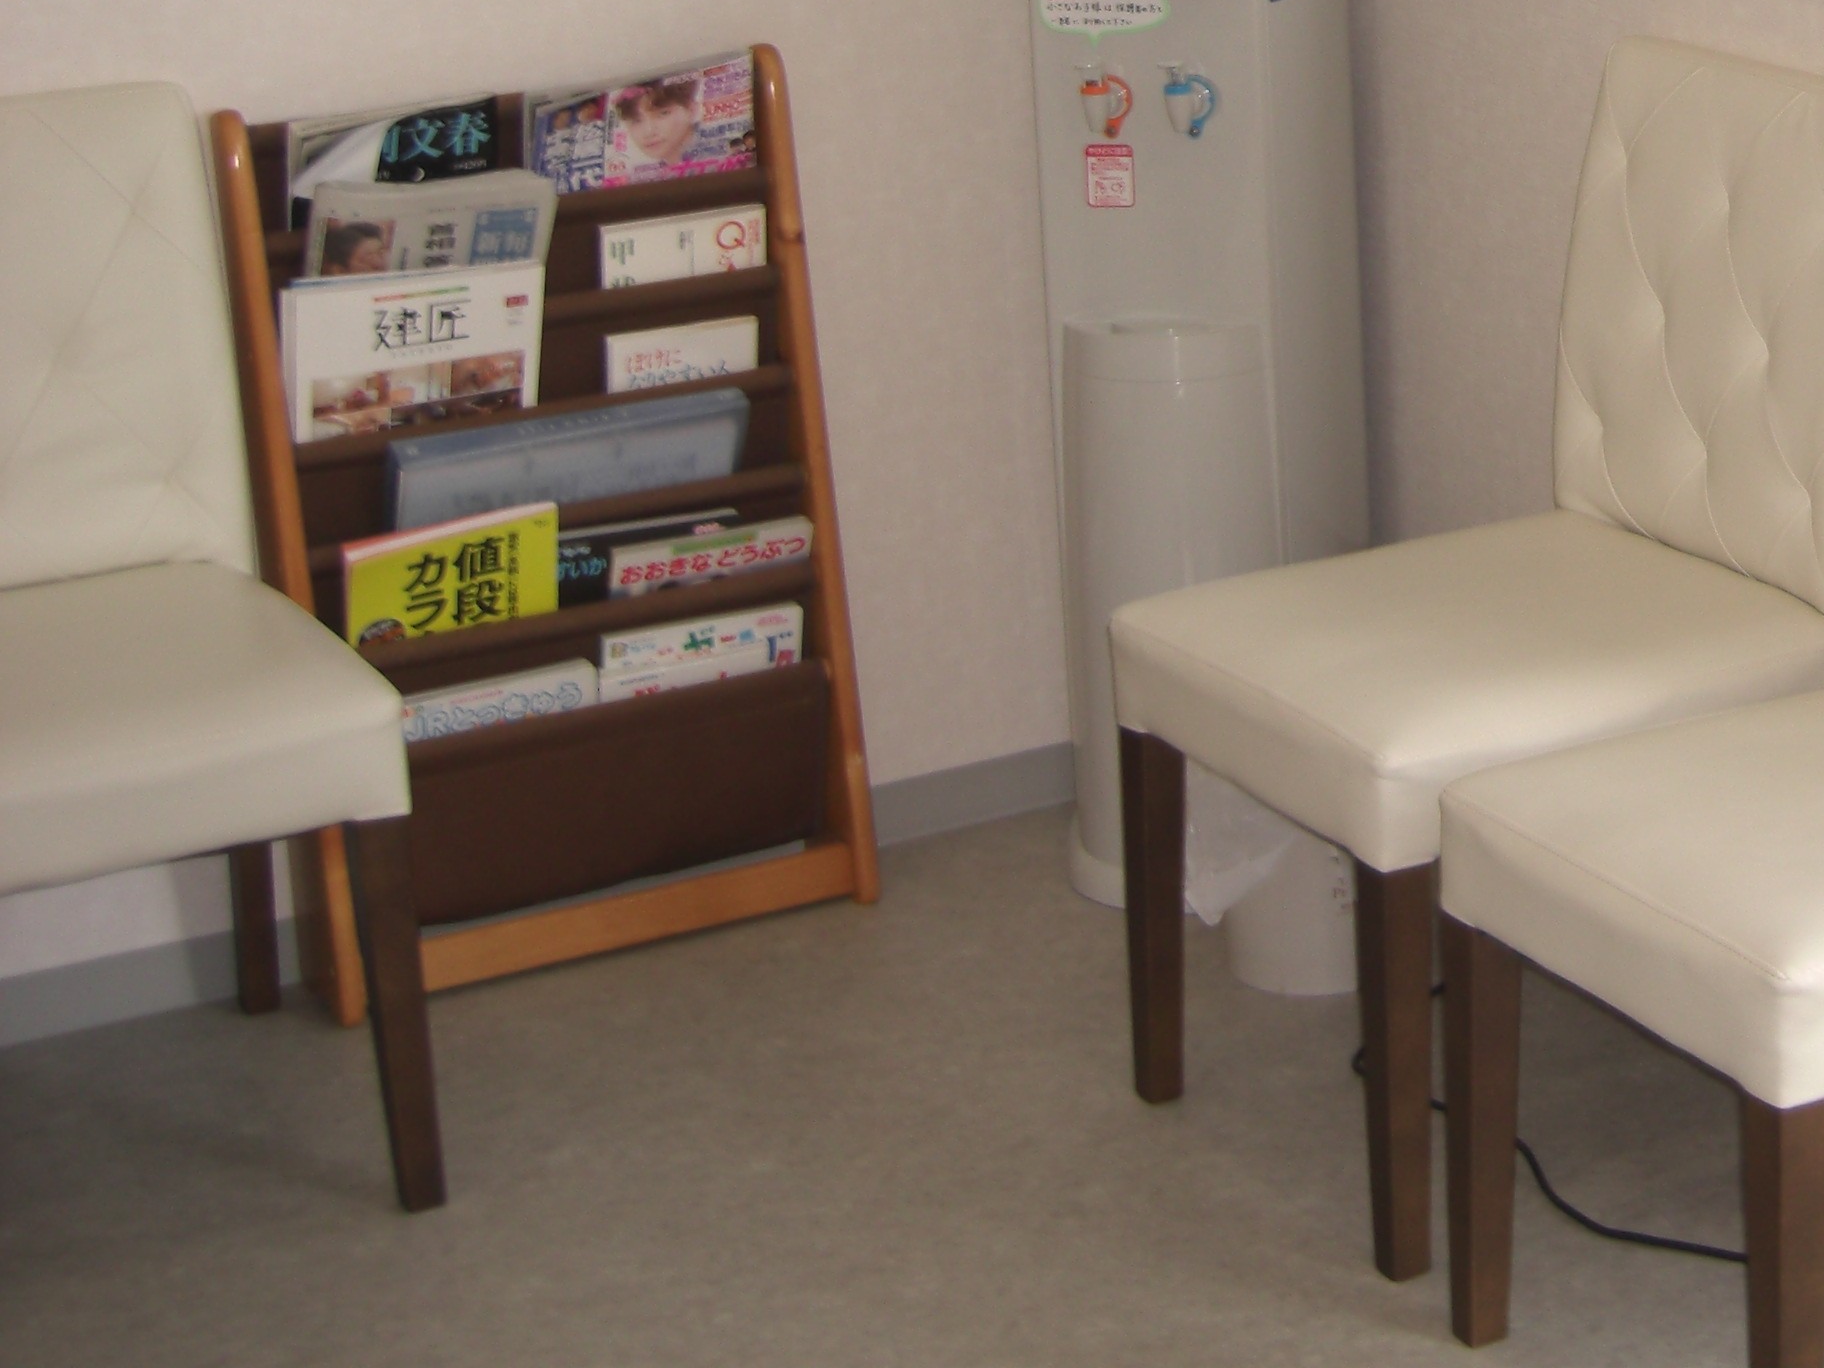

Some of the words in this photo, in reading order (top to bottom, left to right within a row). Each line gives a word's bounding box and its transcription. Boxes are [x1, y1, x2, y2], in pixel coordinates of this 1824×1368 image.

[403, 552, 450, 635] カラ
[452, 536, 506, 626] 値段
[620, 553, 712, 585] おおきな
[716, 536, 806, 567] どうぶつ
